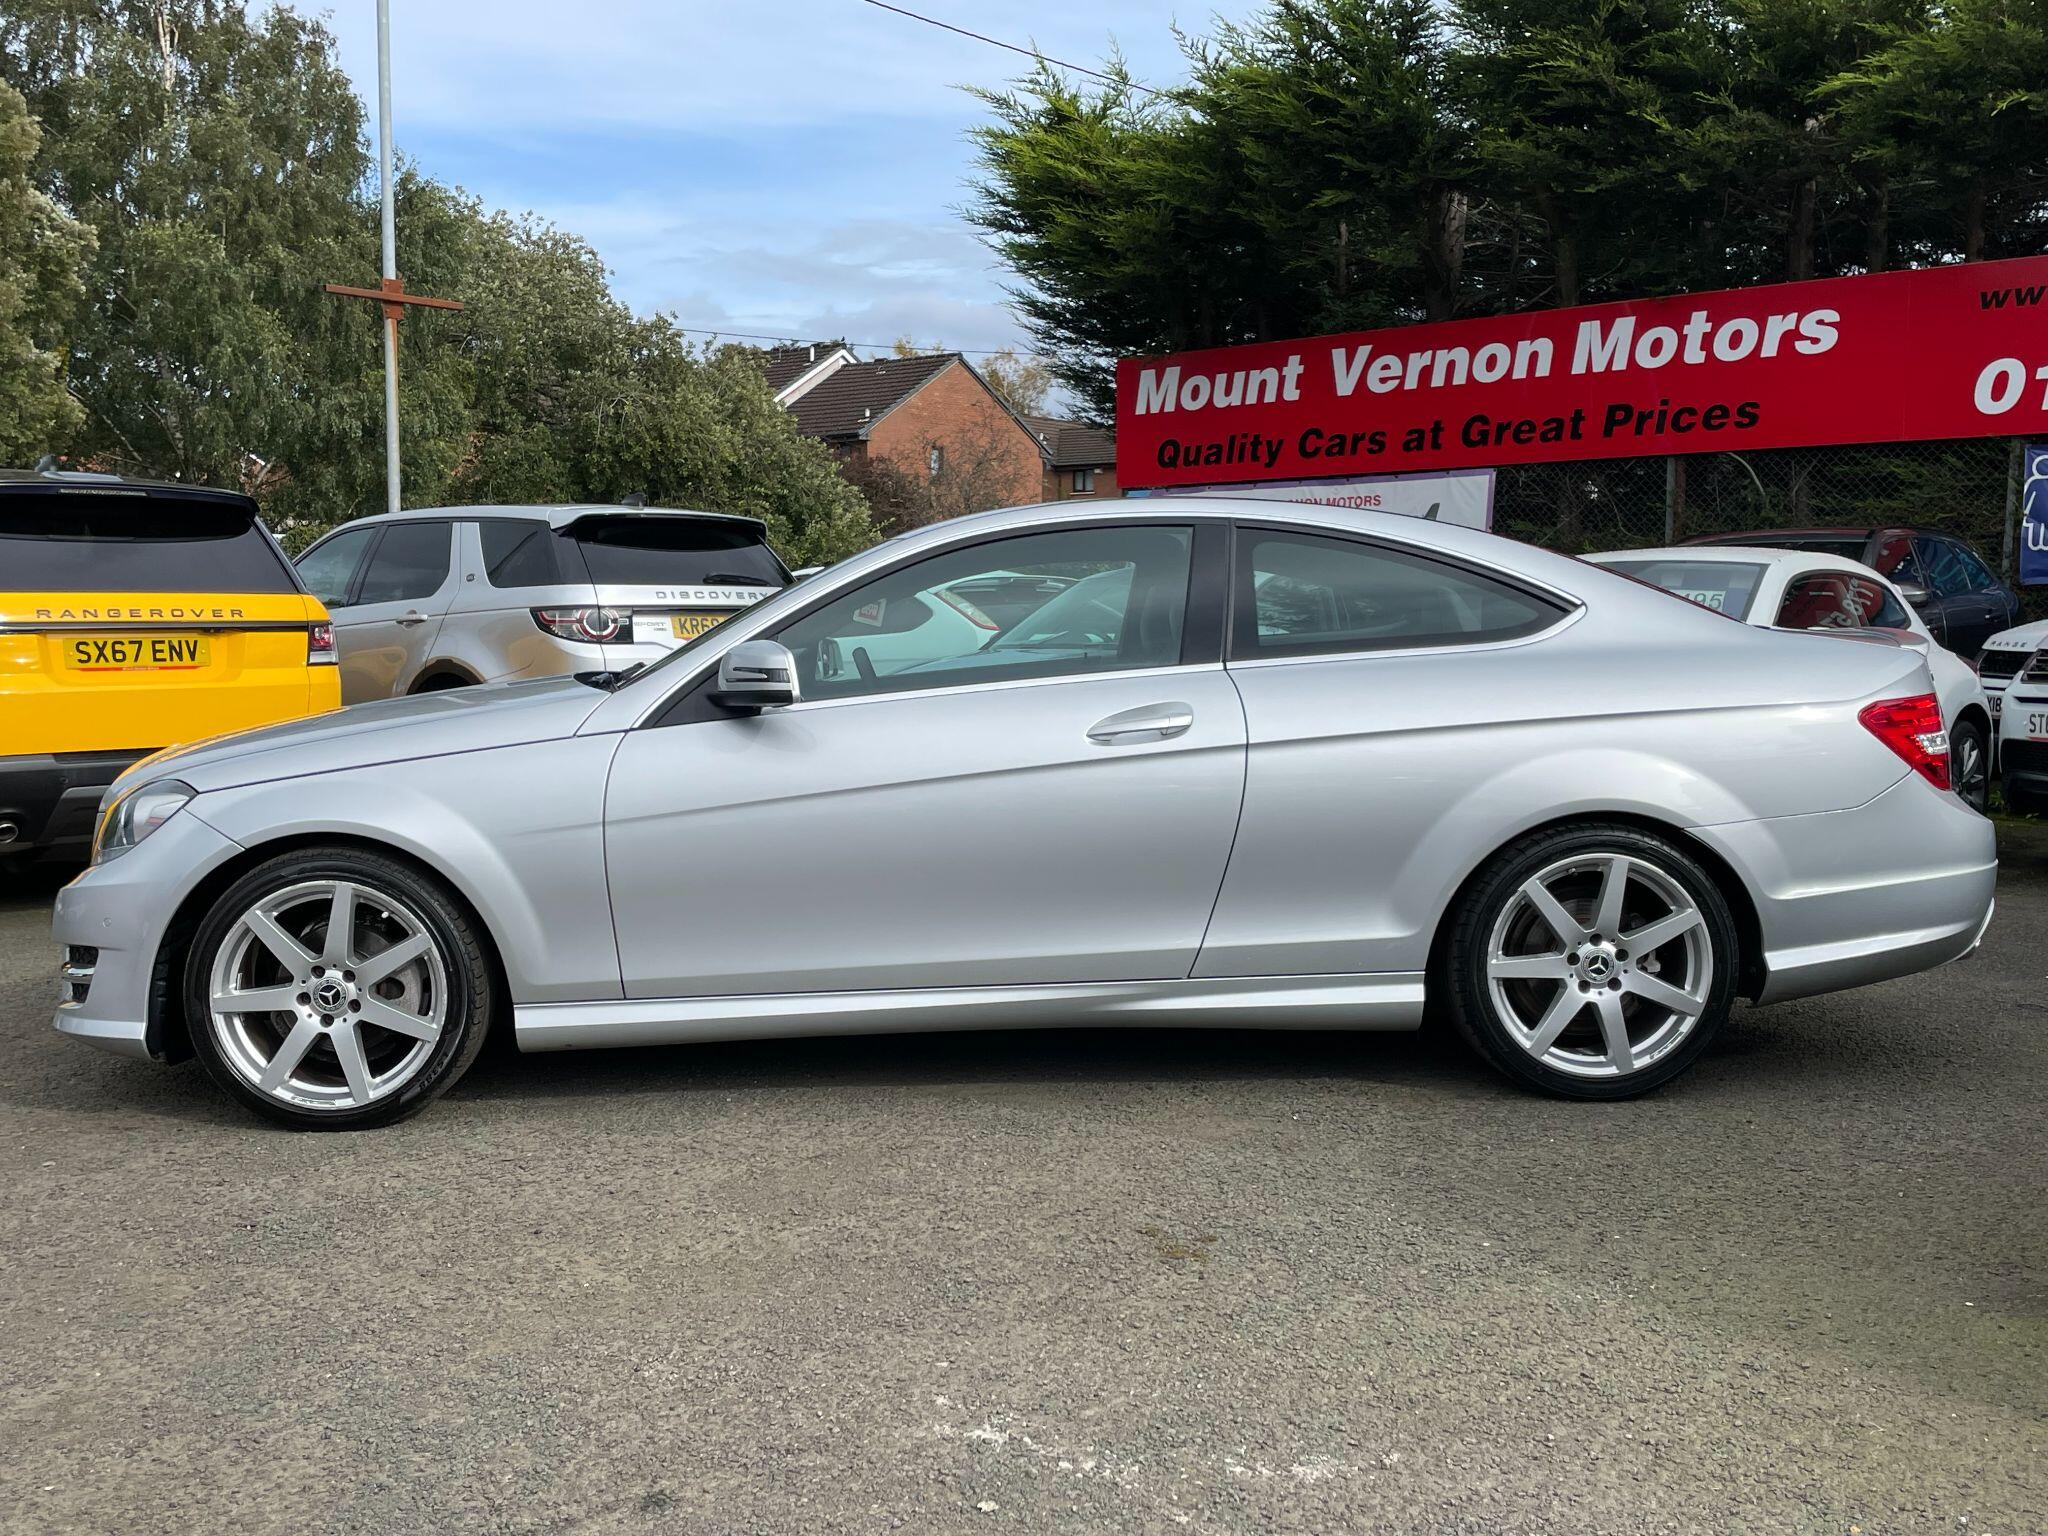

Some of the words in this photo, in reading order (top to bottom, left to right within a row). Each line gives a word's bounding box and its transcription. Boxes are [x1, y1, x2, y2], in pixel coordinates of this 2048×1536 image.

[1135, 355, 1304, 415] Mount
[1331, 337, 1553, 397] Vernon
[1571, 309, 1840, 374] Motors
[1157, 433, 1284, 469] Quality
[1298, 428, 1386, 459] Cars
[1402, 420, 1443, 453] at
[1461, 409, 1585, 448] Great
[1603, 399, 1760, 438] Prices
[1327, 495, 1381, 507] MOTORS
[656, 591, 768, 600] DISCOVERY
[75, 640, 142, 663] SX67
[151, 640, 198, 662] ENV
